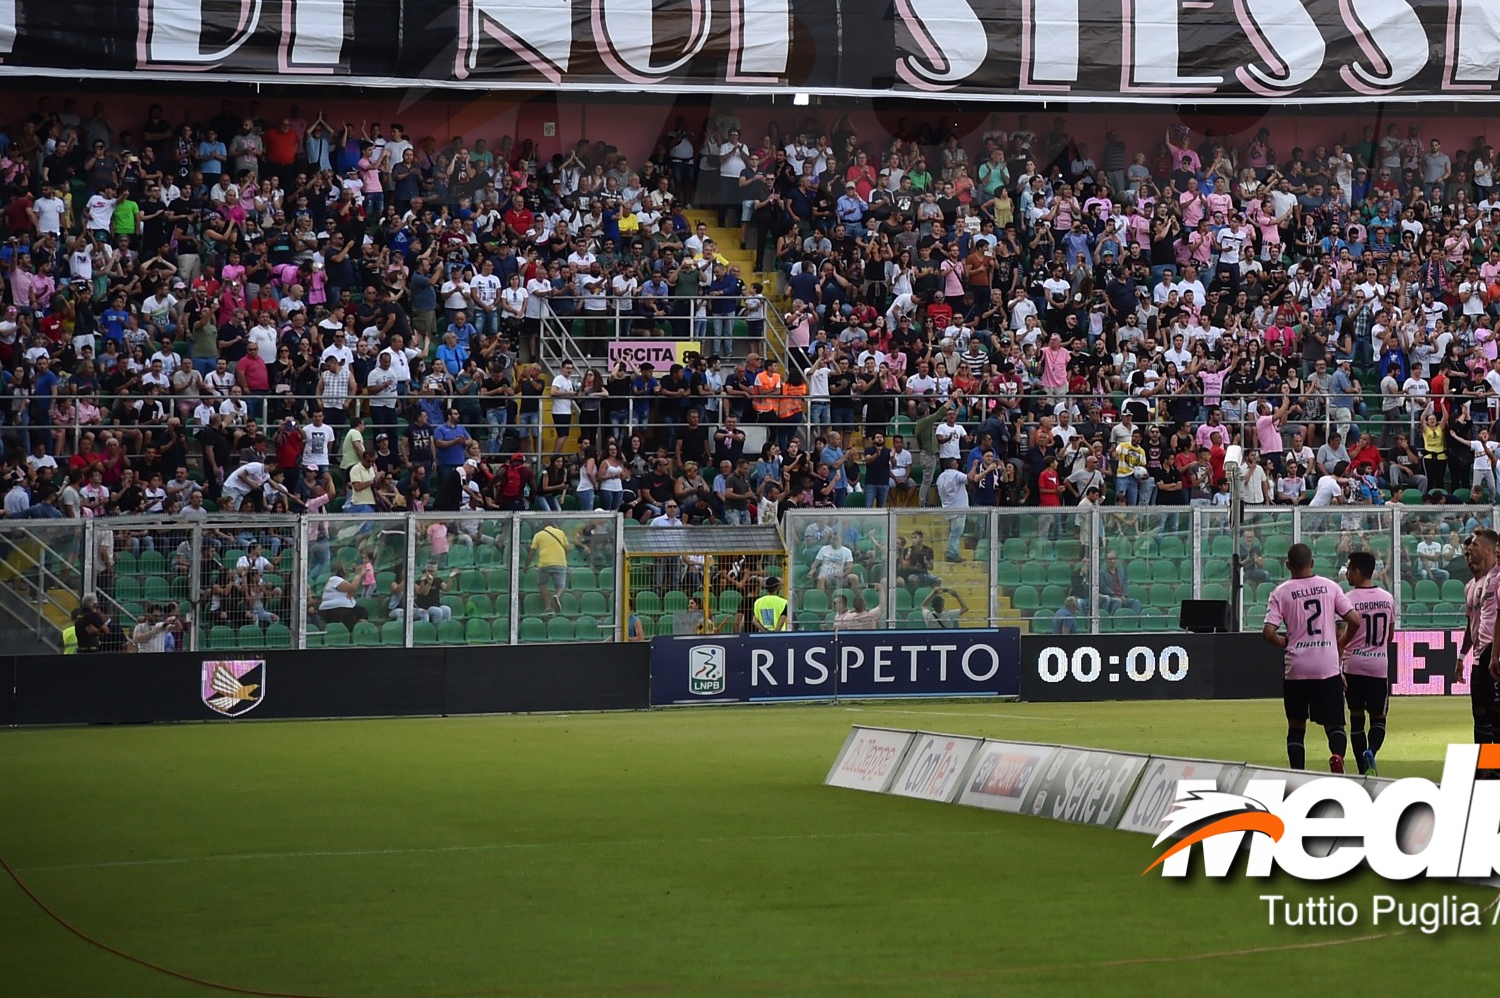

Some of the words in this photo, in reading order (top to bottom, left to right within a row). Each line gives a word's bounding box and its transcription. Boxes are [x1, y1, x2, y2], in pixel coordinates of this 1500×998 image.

[609, 347, 675, 362] USCITA
[1291, 586, 1328, 600] BELLUSCI
[1304, 599, 1321, 636] 2
[1362, 613, 1387, 647] 10
[751, 643, 1000, 687] RISPETTO
[1037, 645, 1190, 683] 00:00
[694, 681, 721, 691] LNPB
[1053, 751, 1109, 824] Serie
[1099, 758, 1137, 825] B
